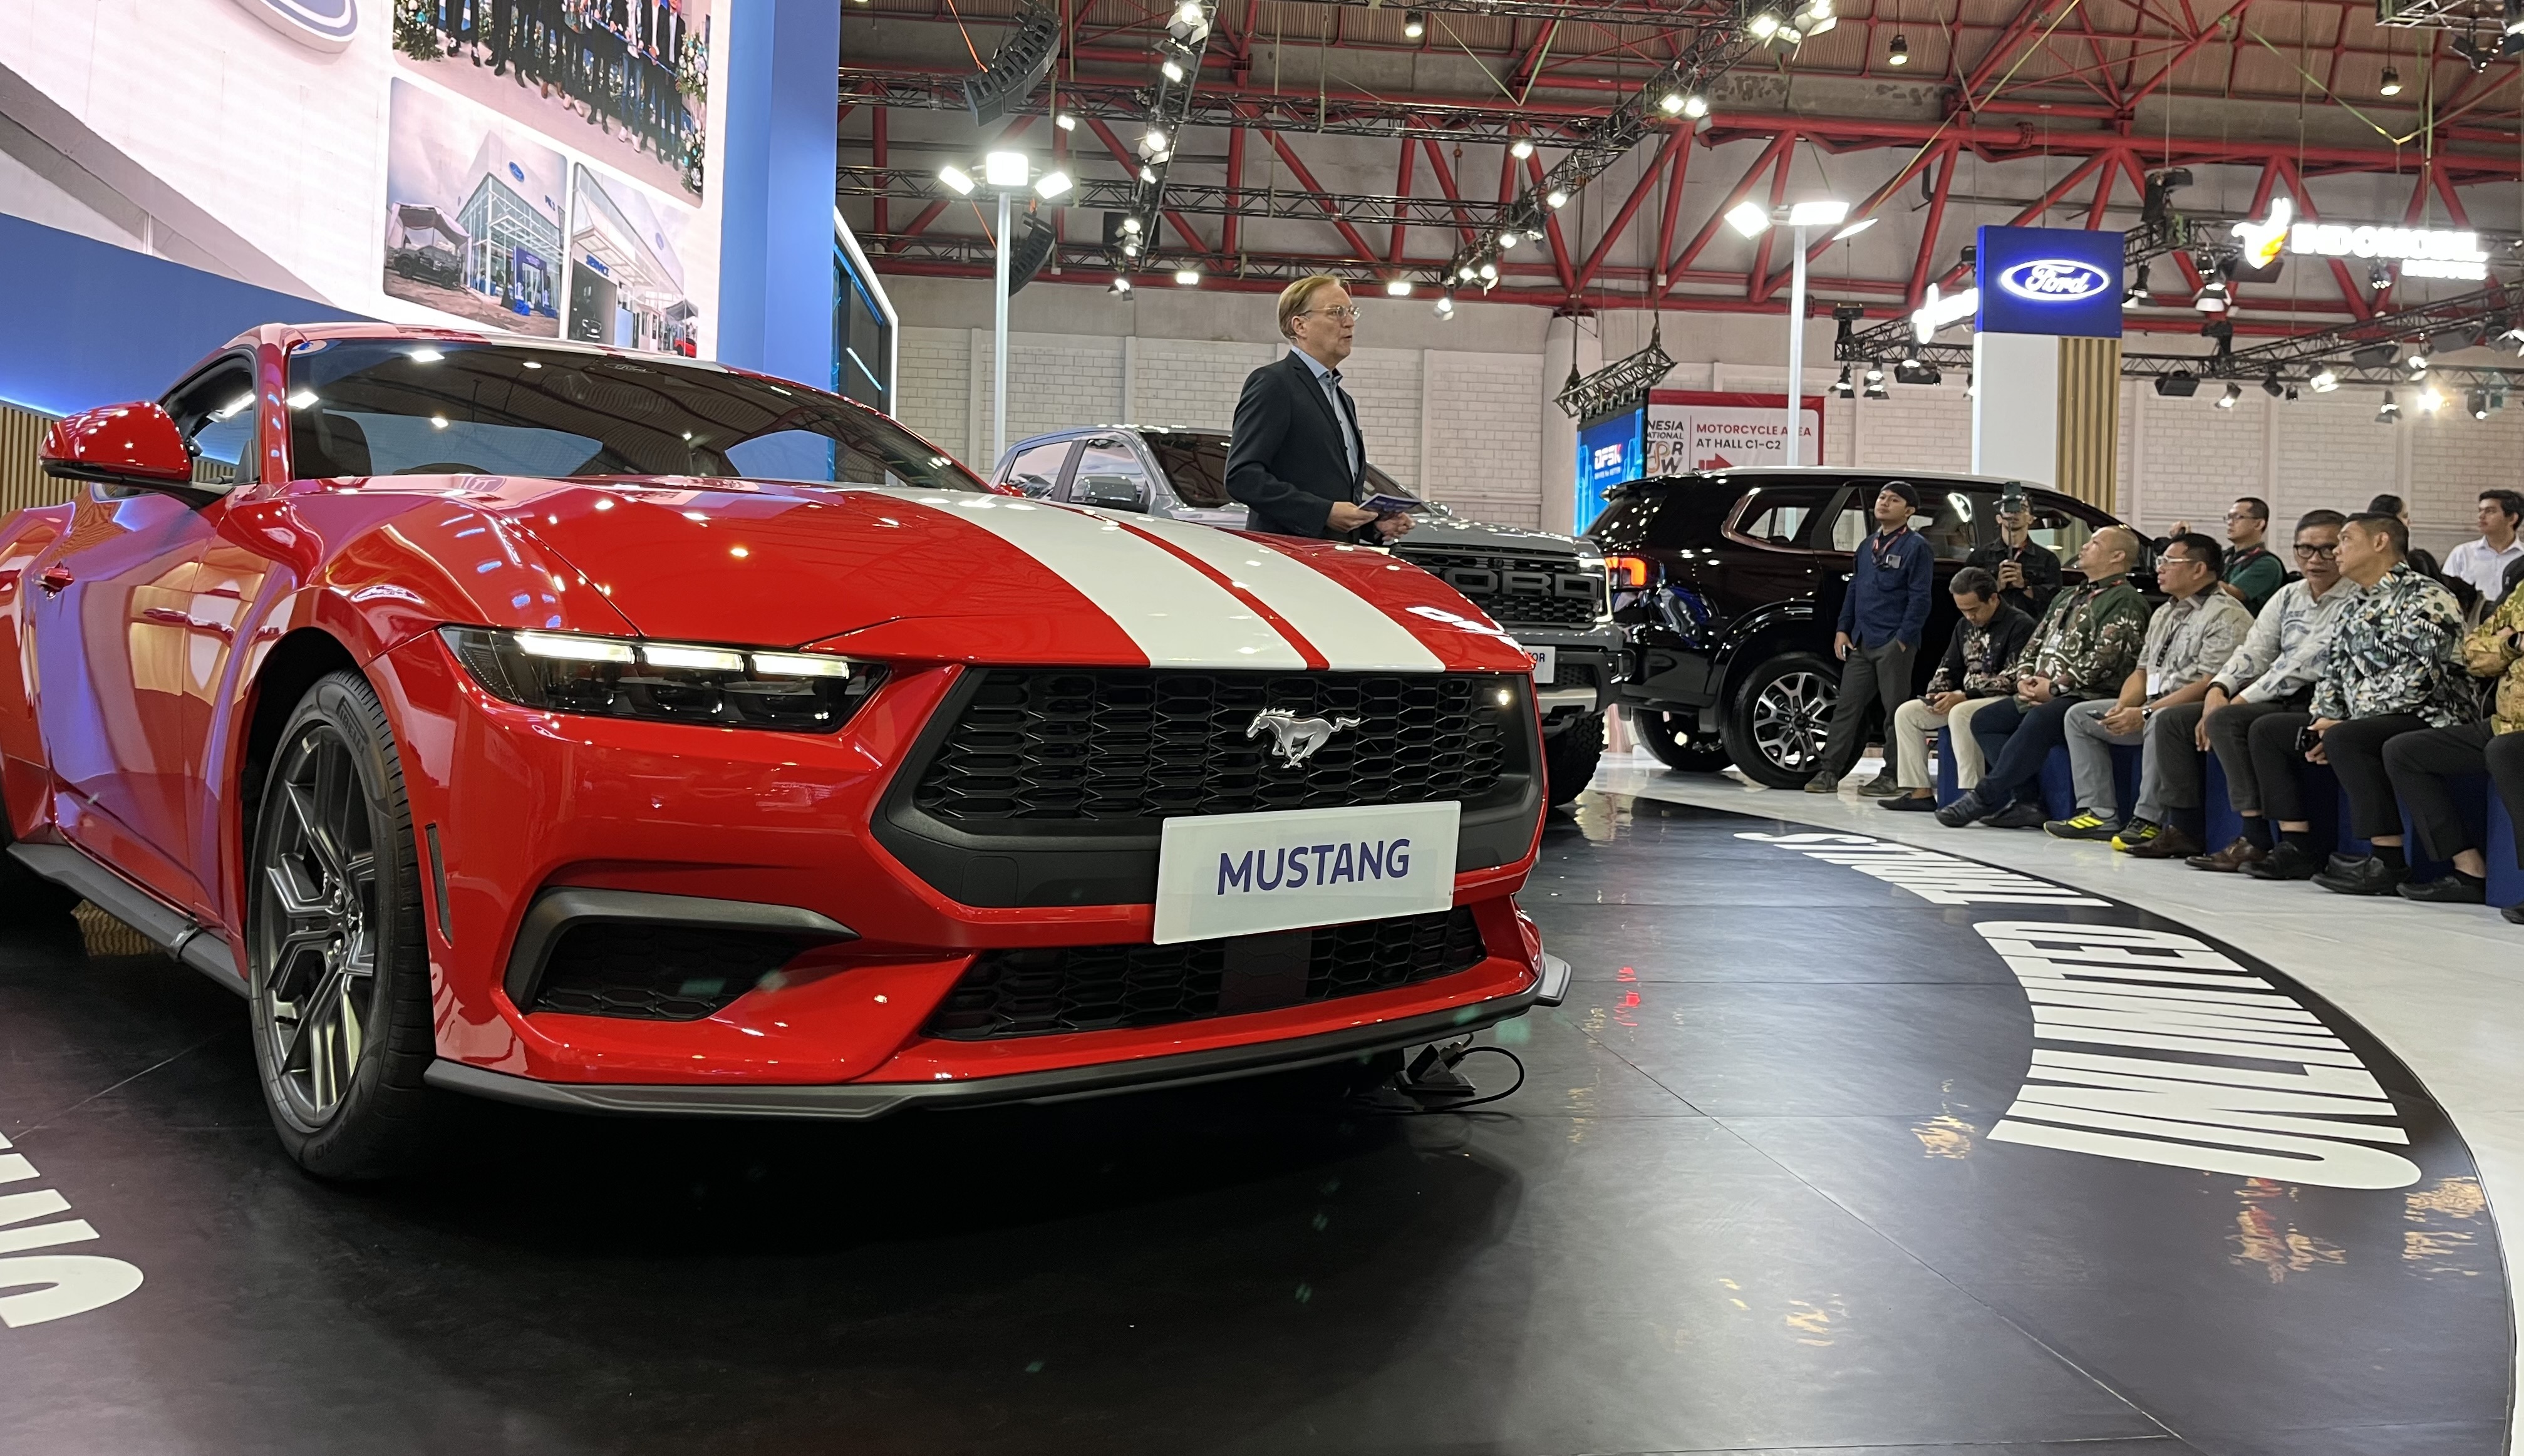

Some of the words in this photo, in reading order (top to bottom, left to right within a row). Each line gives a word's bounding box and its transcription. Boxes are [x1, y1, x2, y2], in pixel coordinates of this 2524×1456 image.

[1647, 420, 1684, 431] NESIA
[1697, 423, 1778, 435] MOTORCYCLE
[1781, 426, 1811, 436] AEA
[1647, 431, 1684, 440] ATIONAL
[1696, 438, 1712, 448] AT
[1714, 439, 1743, 449] HALL
[1745, 440, 1781, 450] C1-C2
[1420, 565, 1599, 599] ORD
[1528, 652, 1545, 663] OR
[1217, 839, 1410, 896] MUSTANG
[1733, 832, 2113, 907] THRILLS
[1973, 921, 2422, 1190] UNLIMITED
